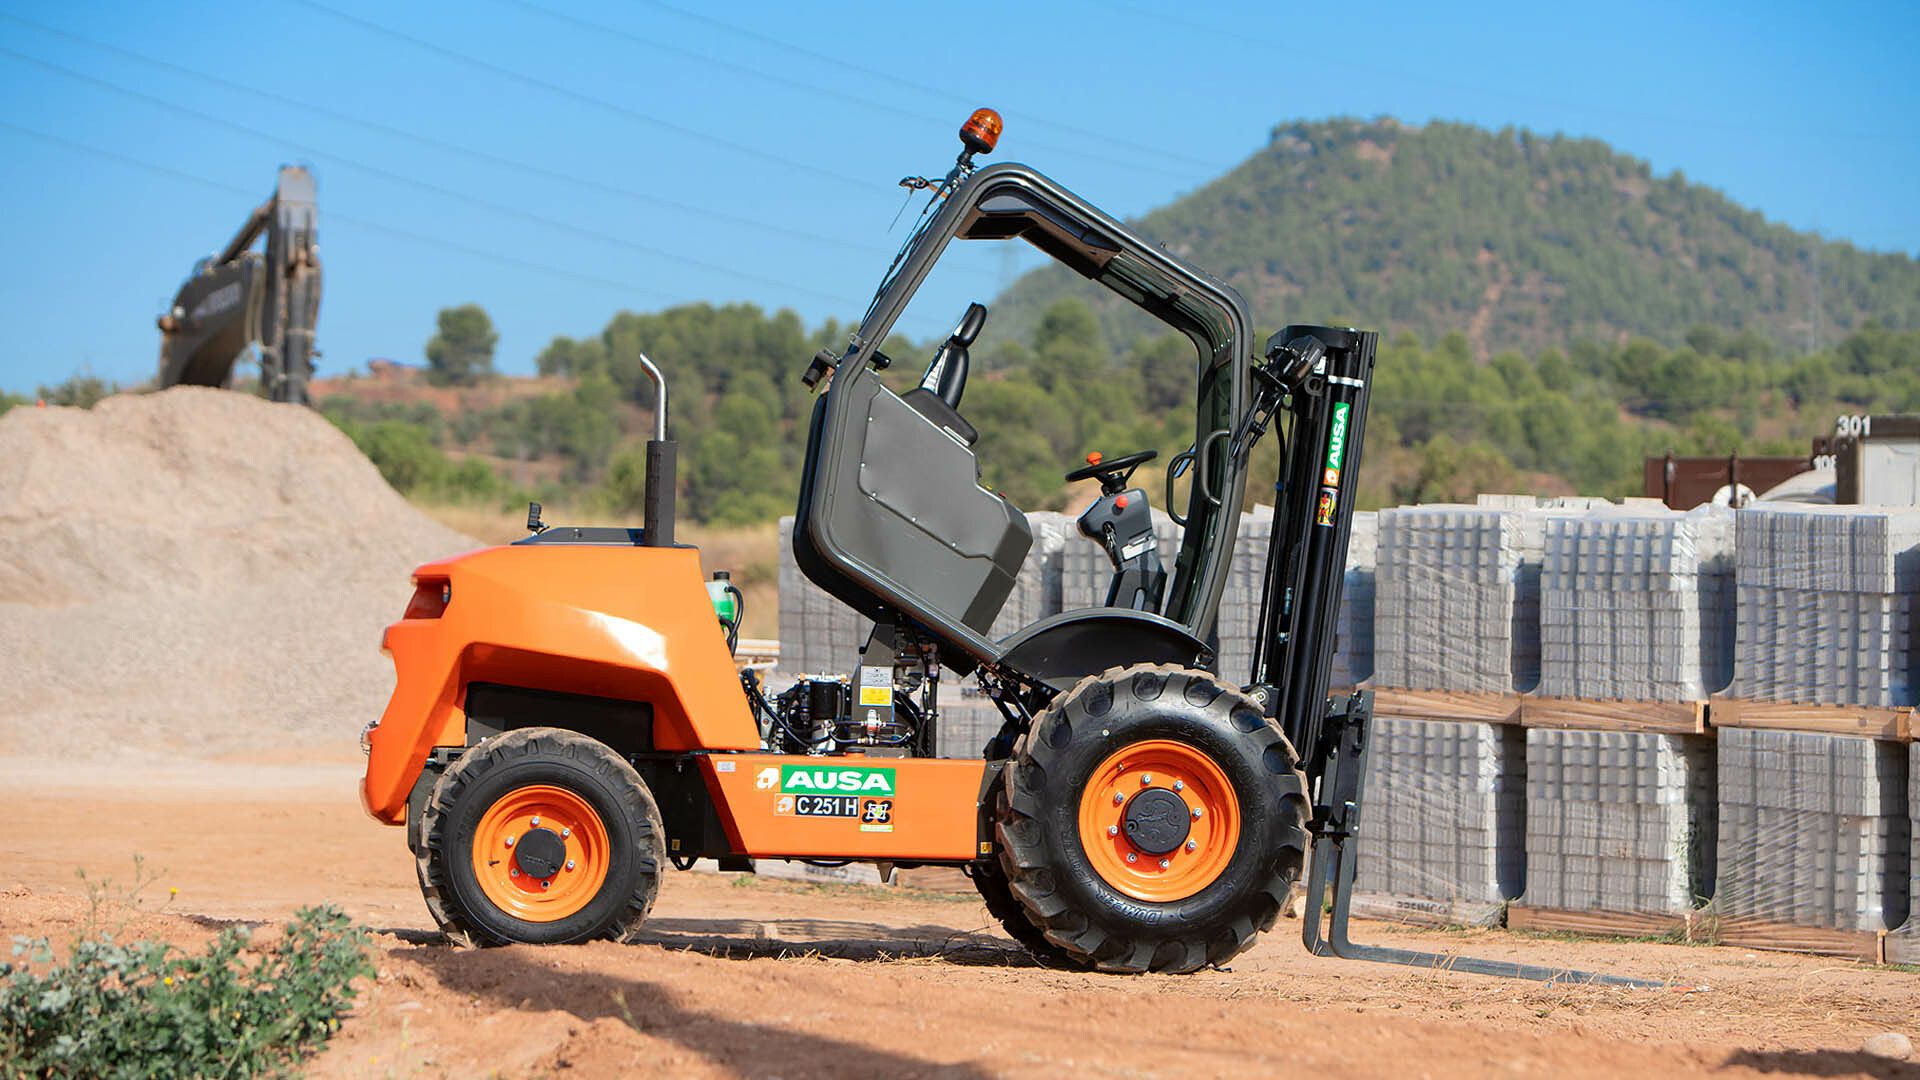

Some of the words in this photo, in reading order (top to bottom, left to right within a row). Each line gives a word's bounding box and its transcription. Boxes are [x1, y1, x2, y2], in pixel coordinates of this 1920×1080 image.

[1837, 415, 1871, 436] 301
[1329, 407, 1347, 468] AUSA
[785, 770, 892, 792] AUSA
[796, 796, 810, 815] C
[814, 797, 840, 815] 251
[845, 798, 858, 816] H
[1096, 887, 1162, 925] DUMPER
